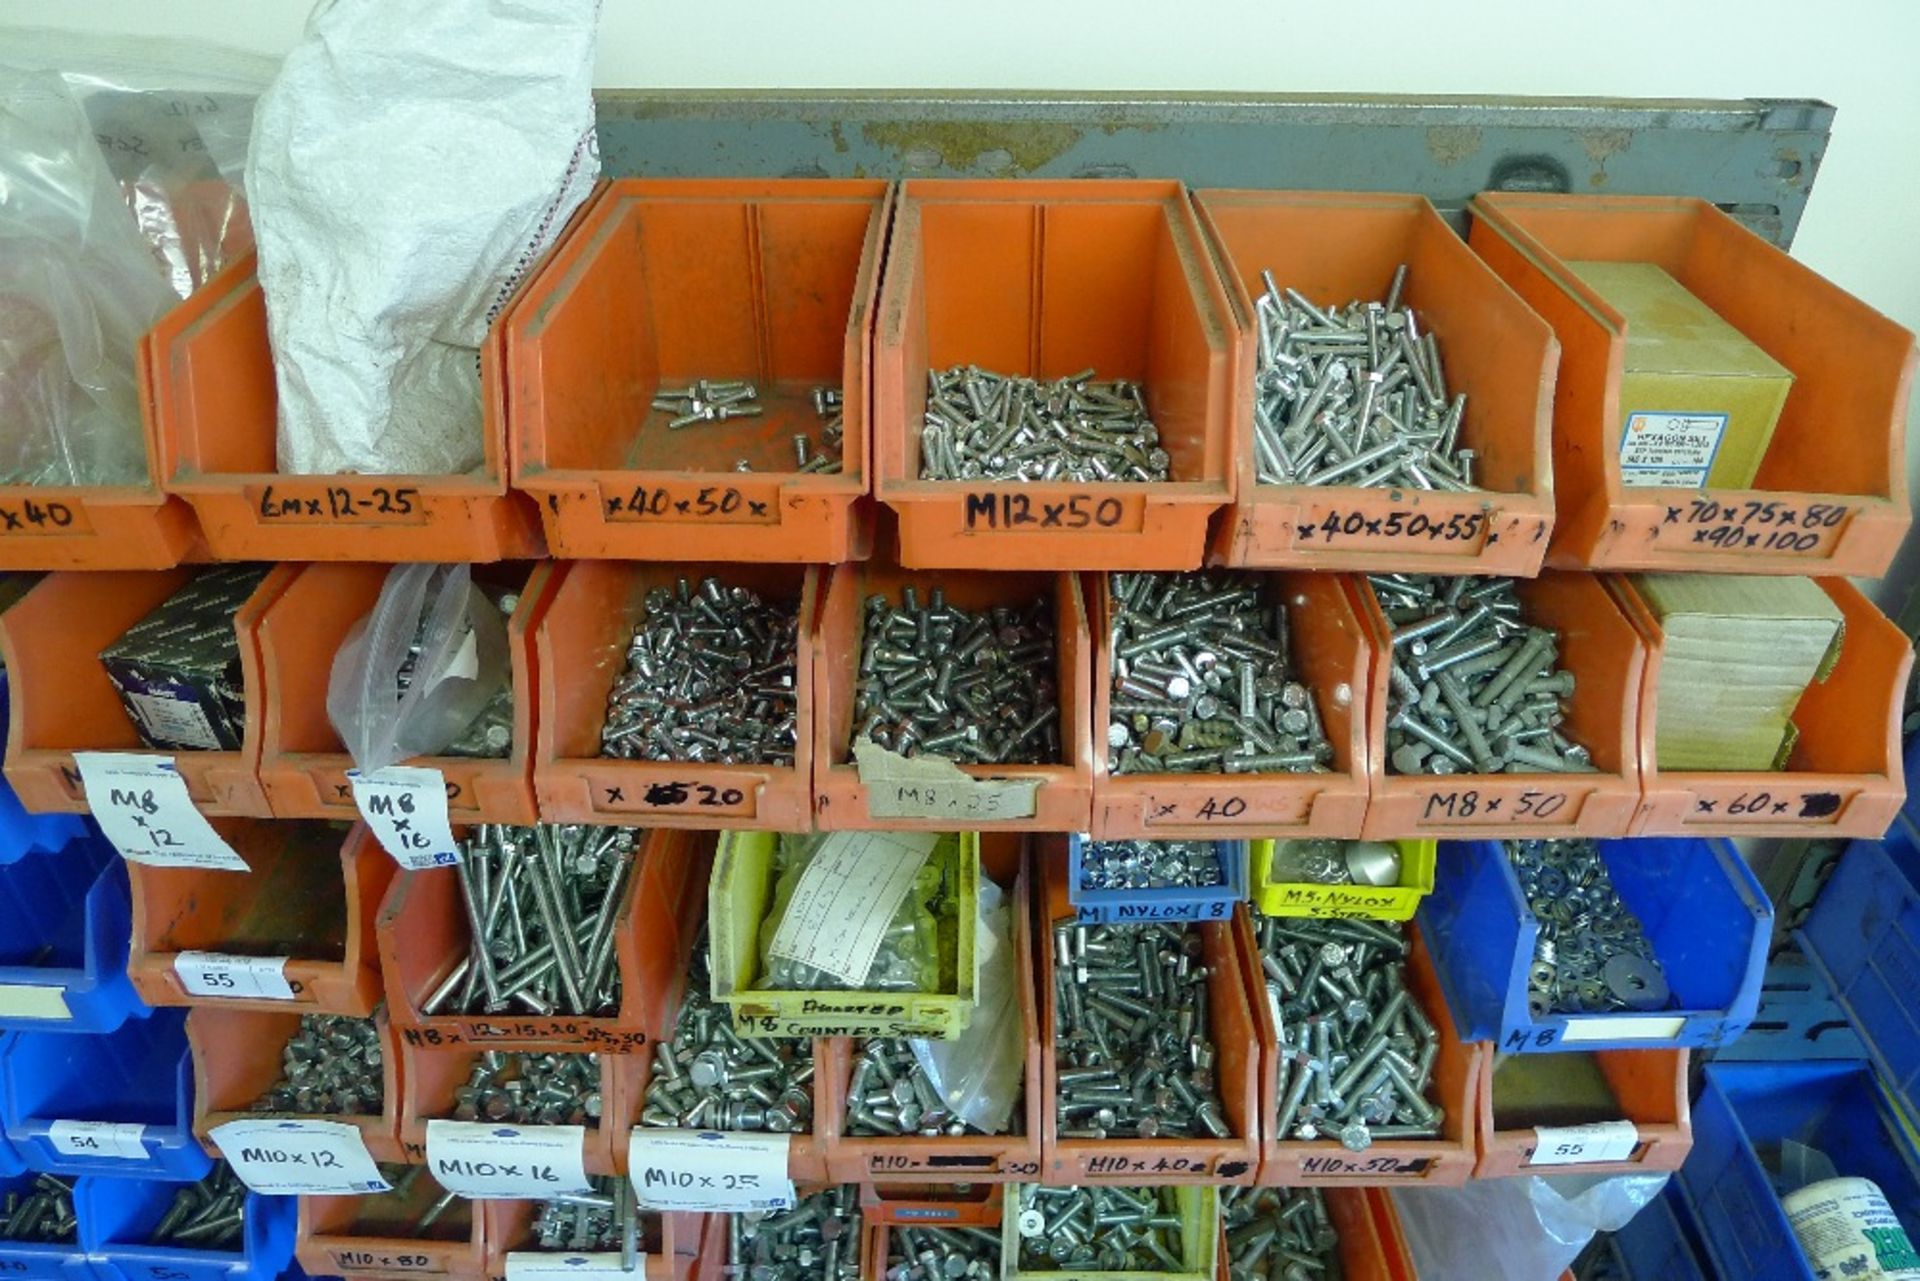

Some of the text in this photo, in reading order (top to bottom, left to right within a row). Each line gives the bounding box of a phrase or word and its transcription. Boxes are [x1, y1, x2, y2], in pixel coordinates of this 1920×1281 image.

[368, 792, 416, 817] M8
[1195, 796, 1247, 820] 40
[149, 829, 185, 848] 12
[401, 831, 431, 850] 16
[1118, 903, 1191, 918] NYLOX
[202, 972, 235, 989] 55
